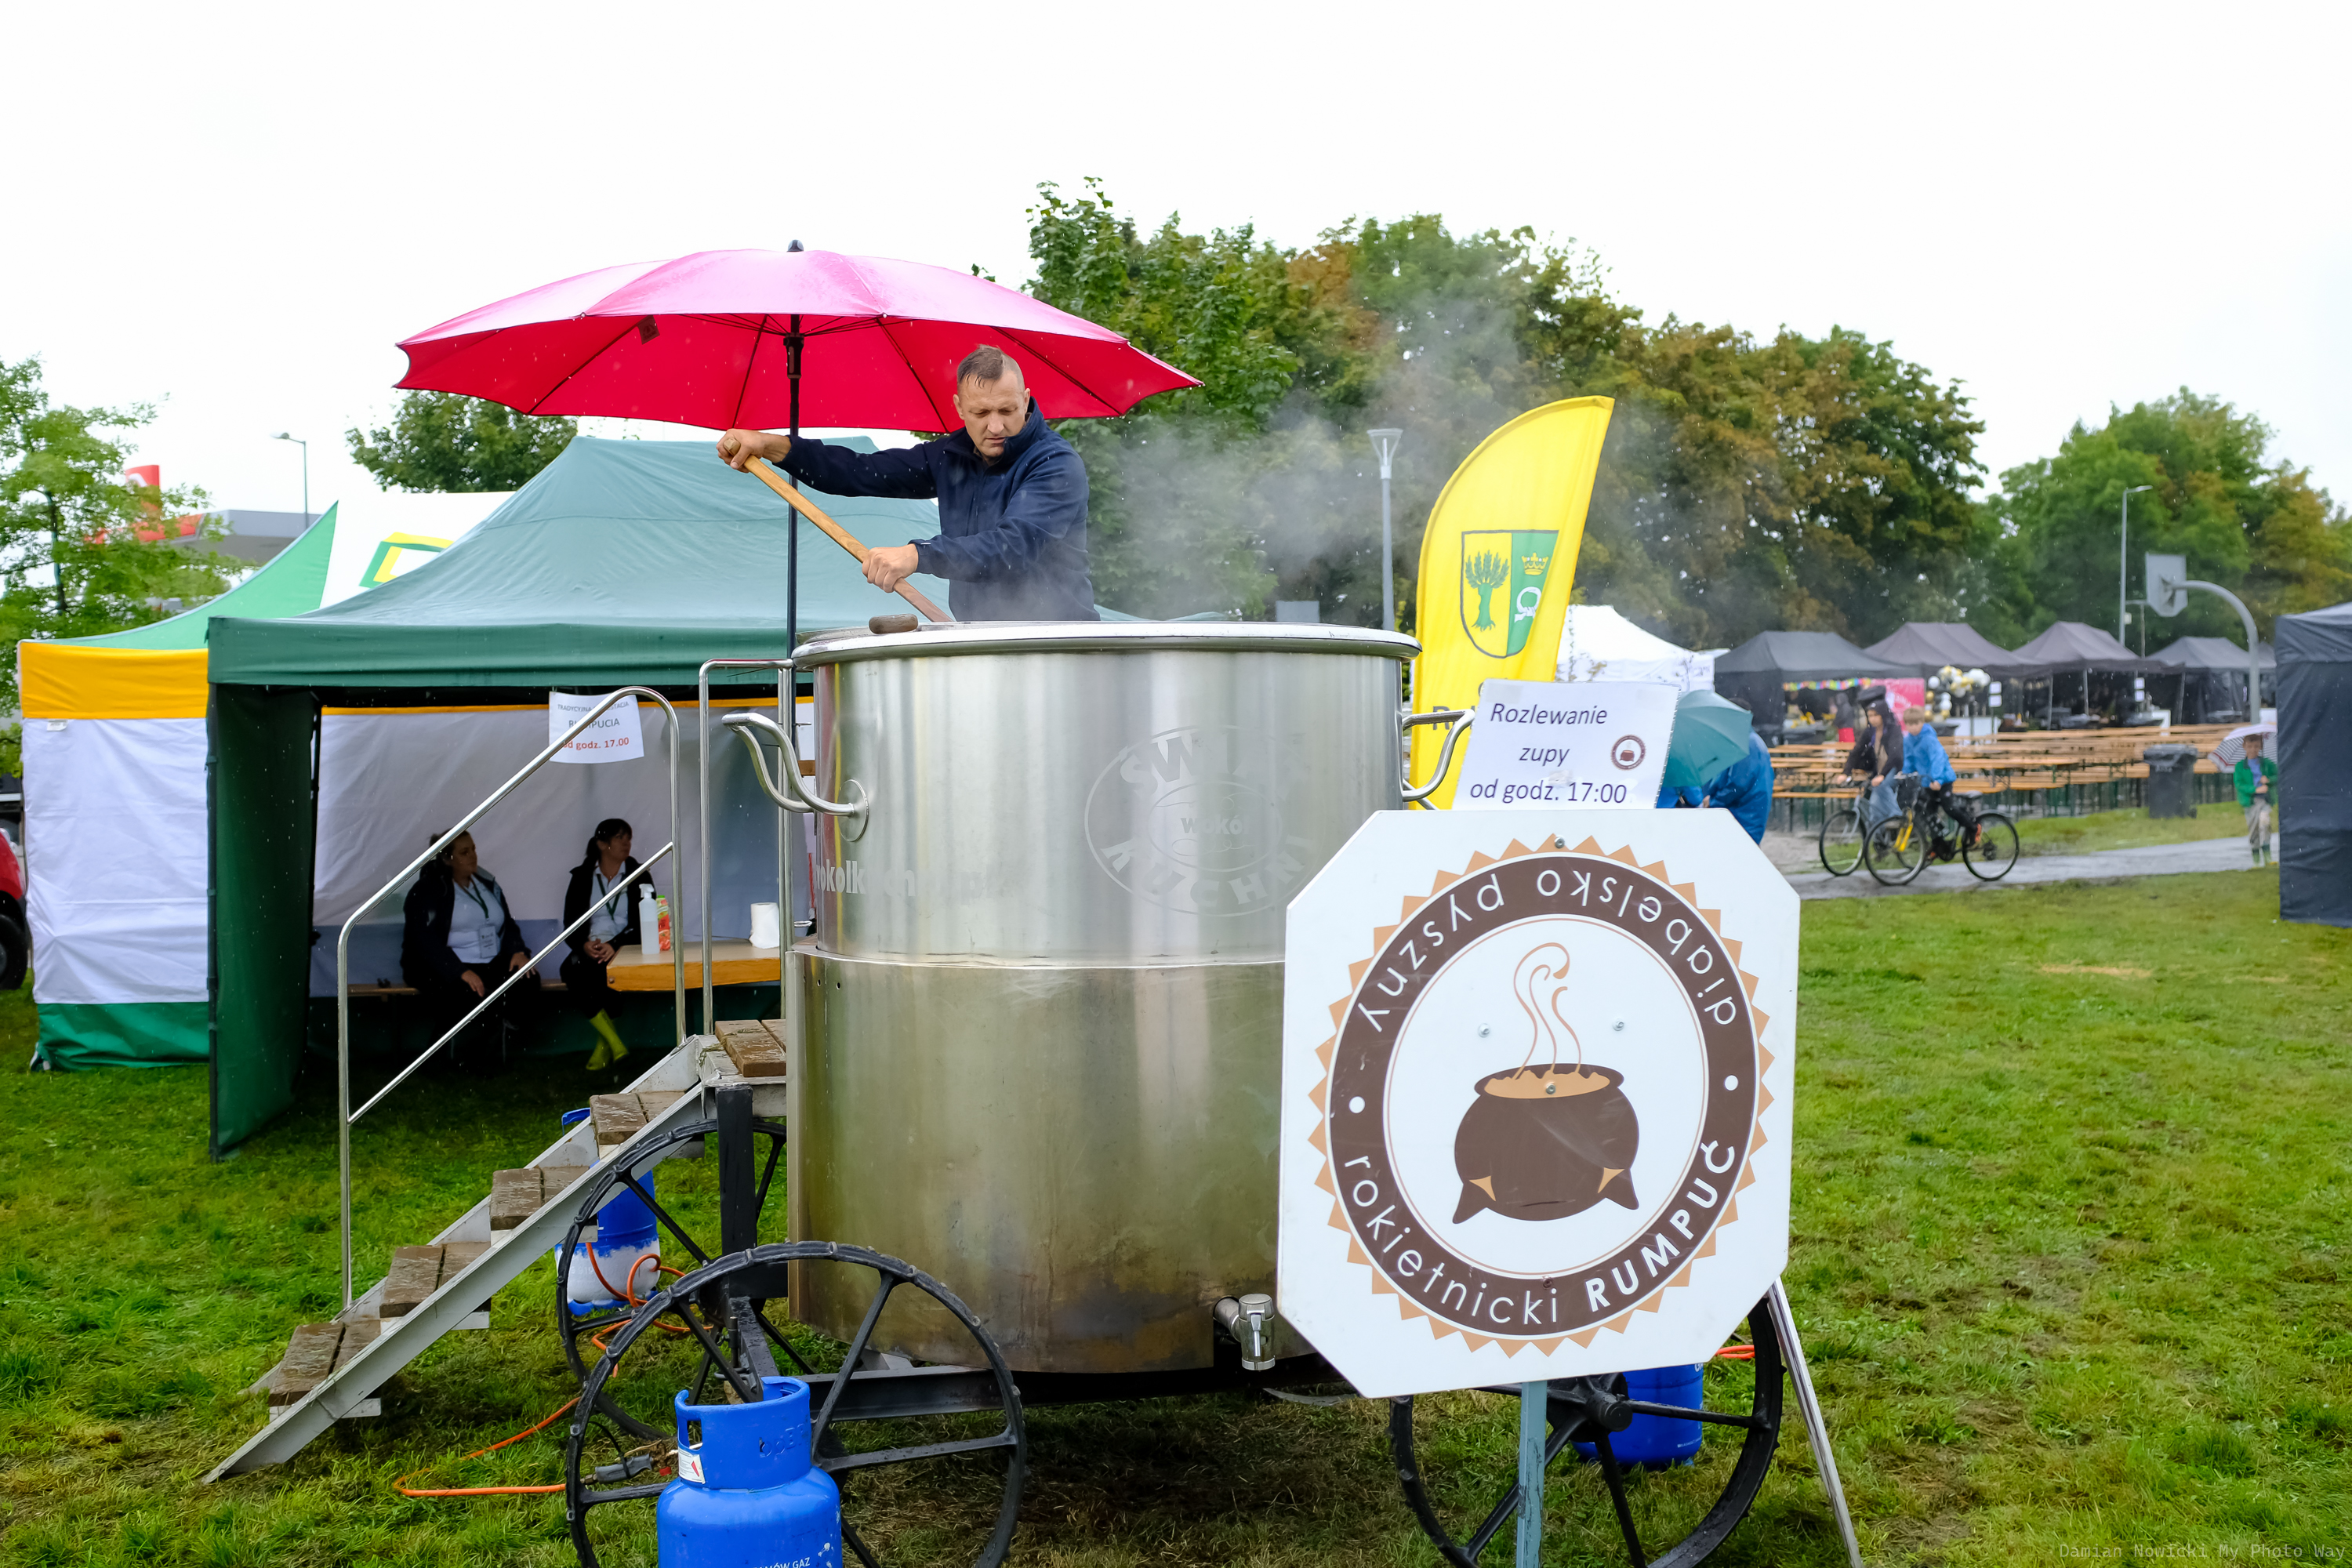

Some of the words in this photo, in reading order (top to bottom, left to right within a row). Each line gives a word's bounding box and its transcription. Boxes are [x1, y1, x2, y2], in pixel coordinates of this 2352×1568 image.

[1490, 703, 1607, 724] Rozlewanie
[576, 741, 601, 751] godz.
[604, 737, 630, 749] 17.00
[1519, 747, 1570, 767] zupy
[1470, 779, 1499, 798] od
[1502, 780, 1559, 804] godz.
[1568, 782, 1627, 804] 17:00
[1100, 834, 1316, 908] KUCHNI
[1358, 873, 1504, 1033] pyszny
[1537, 869, 1737, 1025] diabelsko
[1345, 1156, 1557, 1324] rokietnicki
[1585, 1140, 1735, 1312] RUMPUĆ
[792, 1556, 811, 1568] GAZ
